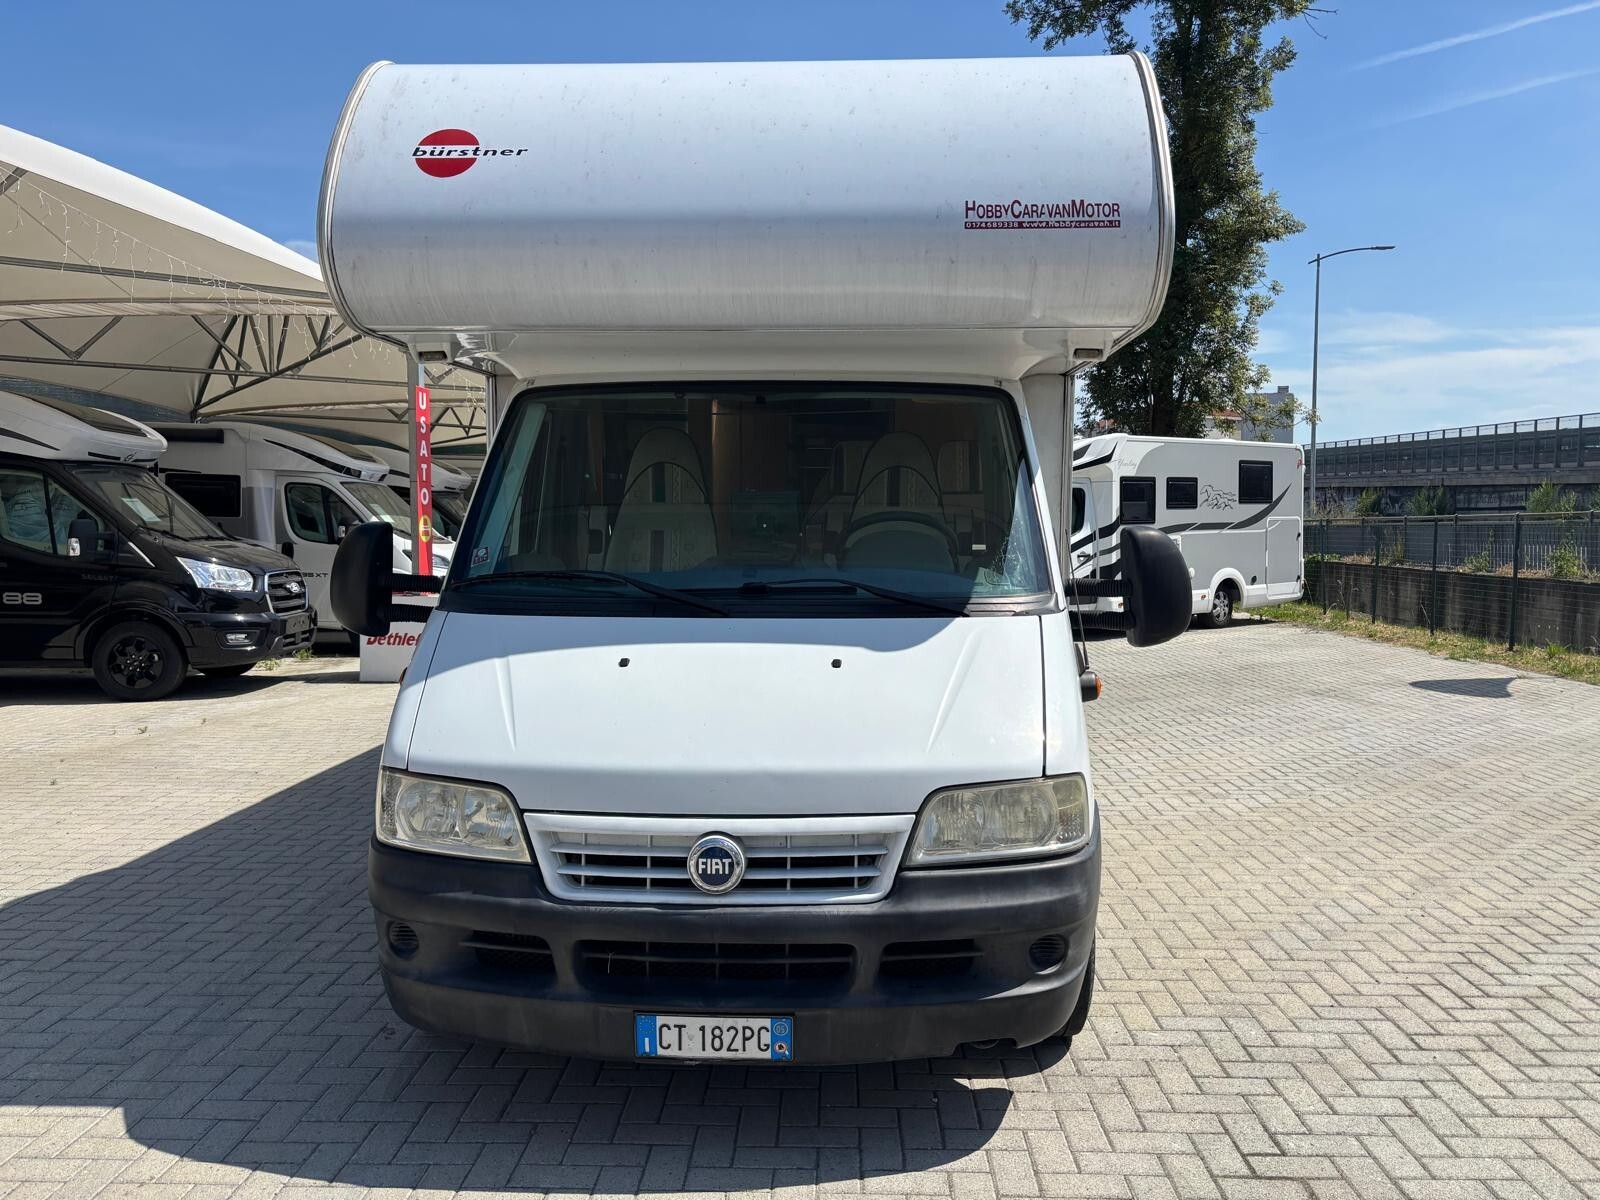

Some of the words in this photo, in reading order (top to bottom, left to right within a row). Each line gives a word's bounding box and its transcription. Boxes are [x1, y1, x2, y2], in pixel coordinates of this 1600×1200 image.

[412, 146, 528, 157] bürstner
[419, 391, 430, 505] USATO
[3, 592, 42, 605] 88
[698, 858, 732, 875] FIAT
